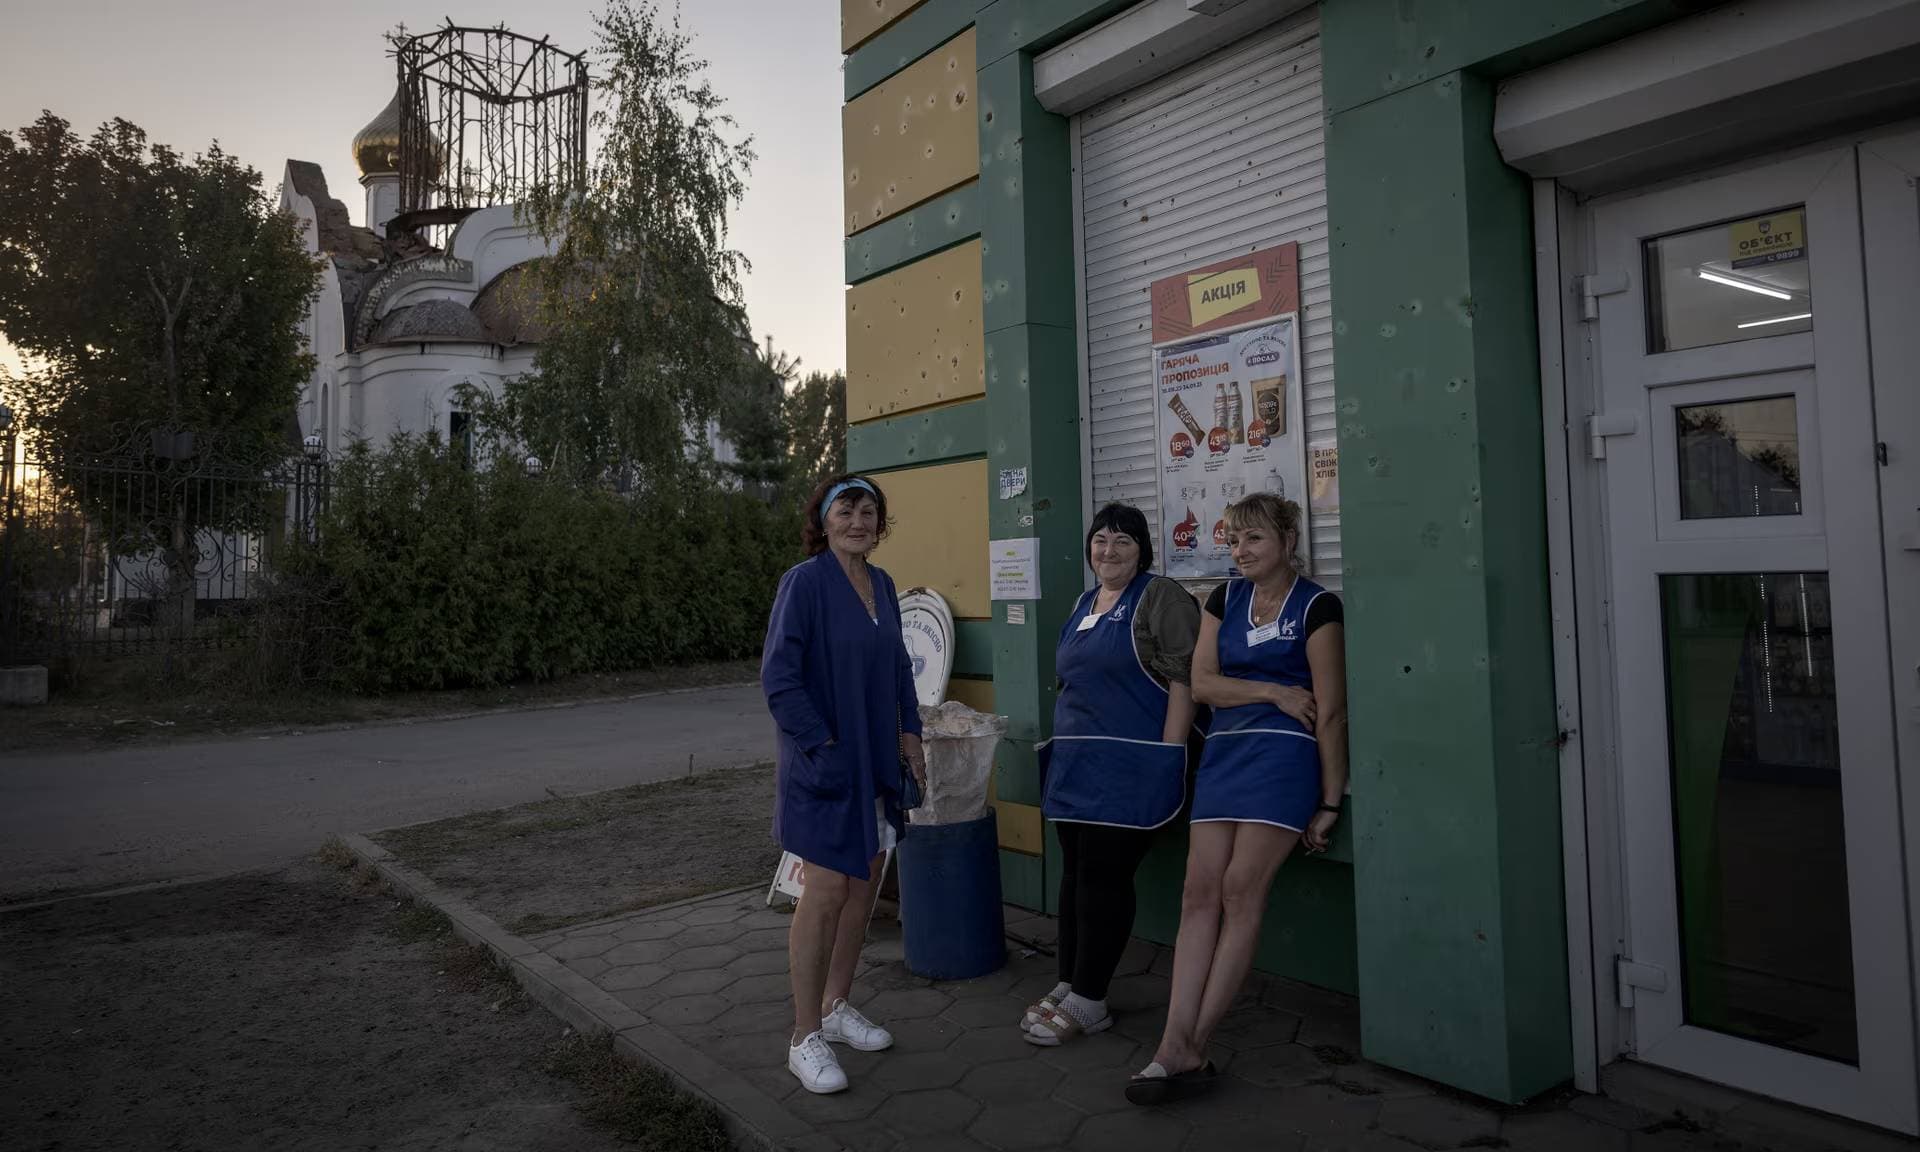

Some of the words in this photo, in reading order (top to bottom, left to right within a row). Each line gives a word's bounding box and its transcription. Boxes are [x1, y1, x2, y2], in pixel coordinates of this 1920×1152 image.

[1201, 280, 1246, 304] АКЦІЯ
[1161, 354, 1200, 370] ГАРЯЧА
[1161, 362, 1229, 385] ПРОПОЗИЦІЯ
[1314, 450, 1321, 458] В
[1315, 469, 1336, 479] ХЛІБ
[1001, 478, 1026, 488] ДВЕРИ
